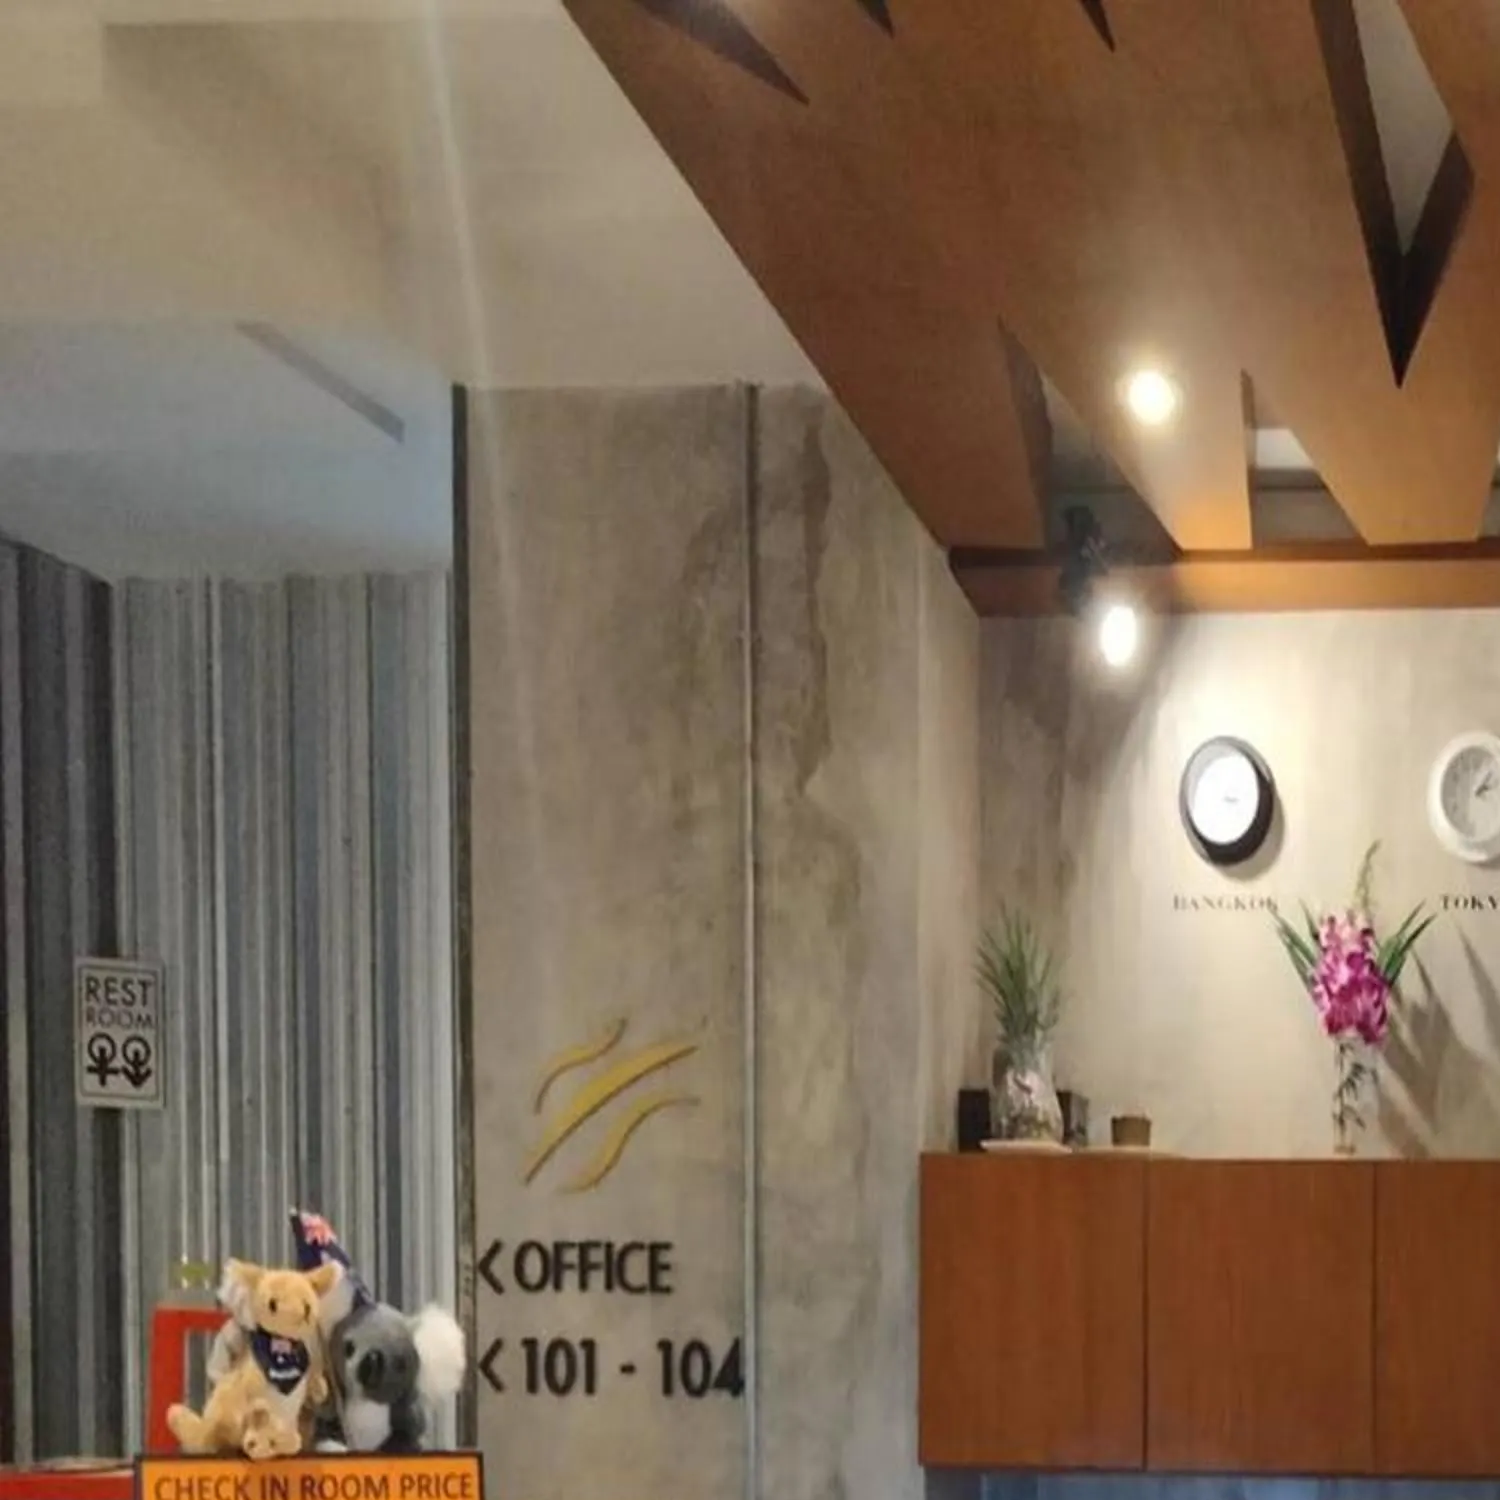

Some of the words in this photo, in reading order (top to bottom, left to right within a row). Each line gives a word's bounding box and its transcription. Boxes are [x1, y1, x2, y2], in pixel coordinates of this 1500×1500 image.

[1172, 895, 1279, 912] BANGKOK
[85, 975, 154, 1008] REST
[85, 1006, 156, 1029] ROOM
[513, 1239, 674, 1295] OFFICE
[520, 1336, 597, 1397] 101
[656, 1336, 745, 1399] 104
[400, 1471, 475, 1500] PRICE
